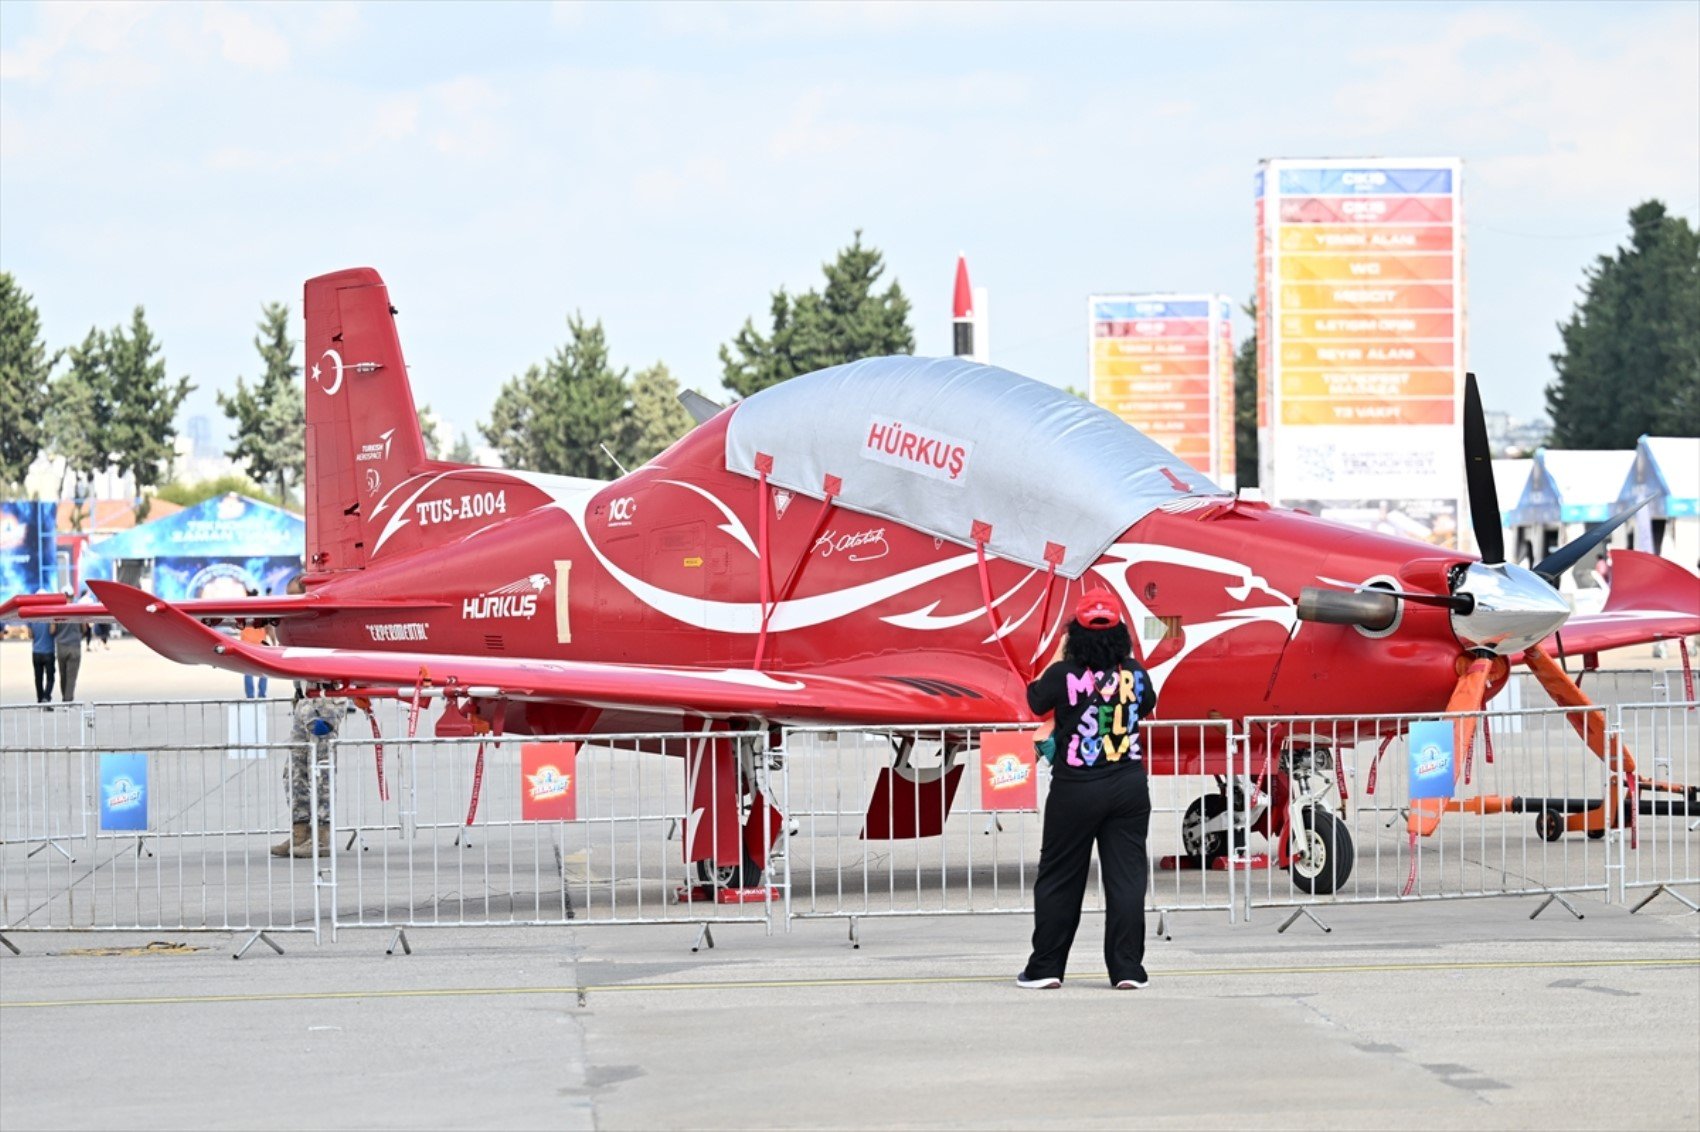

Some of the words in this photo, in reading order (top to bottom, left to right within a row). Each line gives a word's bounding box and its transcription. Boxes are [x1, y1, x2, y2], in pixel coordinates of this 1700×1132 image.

[1349, 262, 1381, 275] WC
[362, 443, 384, 453] TURKISH
[867, 422, 965, 480] HÜRKUŞ
[416, 489, 506, 526] TUS-A004
[462, 592, 538, 620] HÜRKUŞ
[1066, 667, 1144, 706] MORE
[1077, 702, 1140, 738] SELF
[1066, 733, 1142, 767] LOVE
